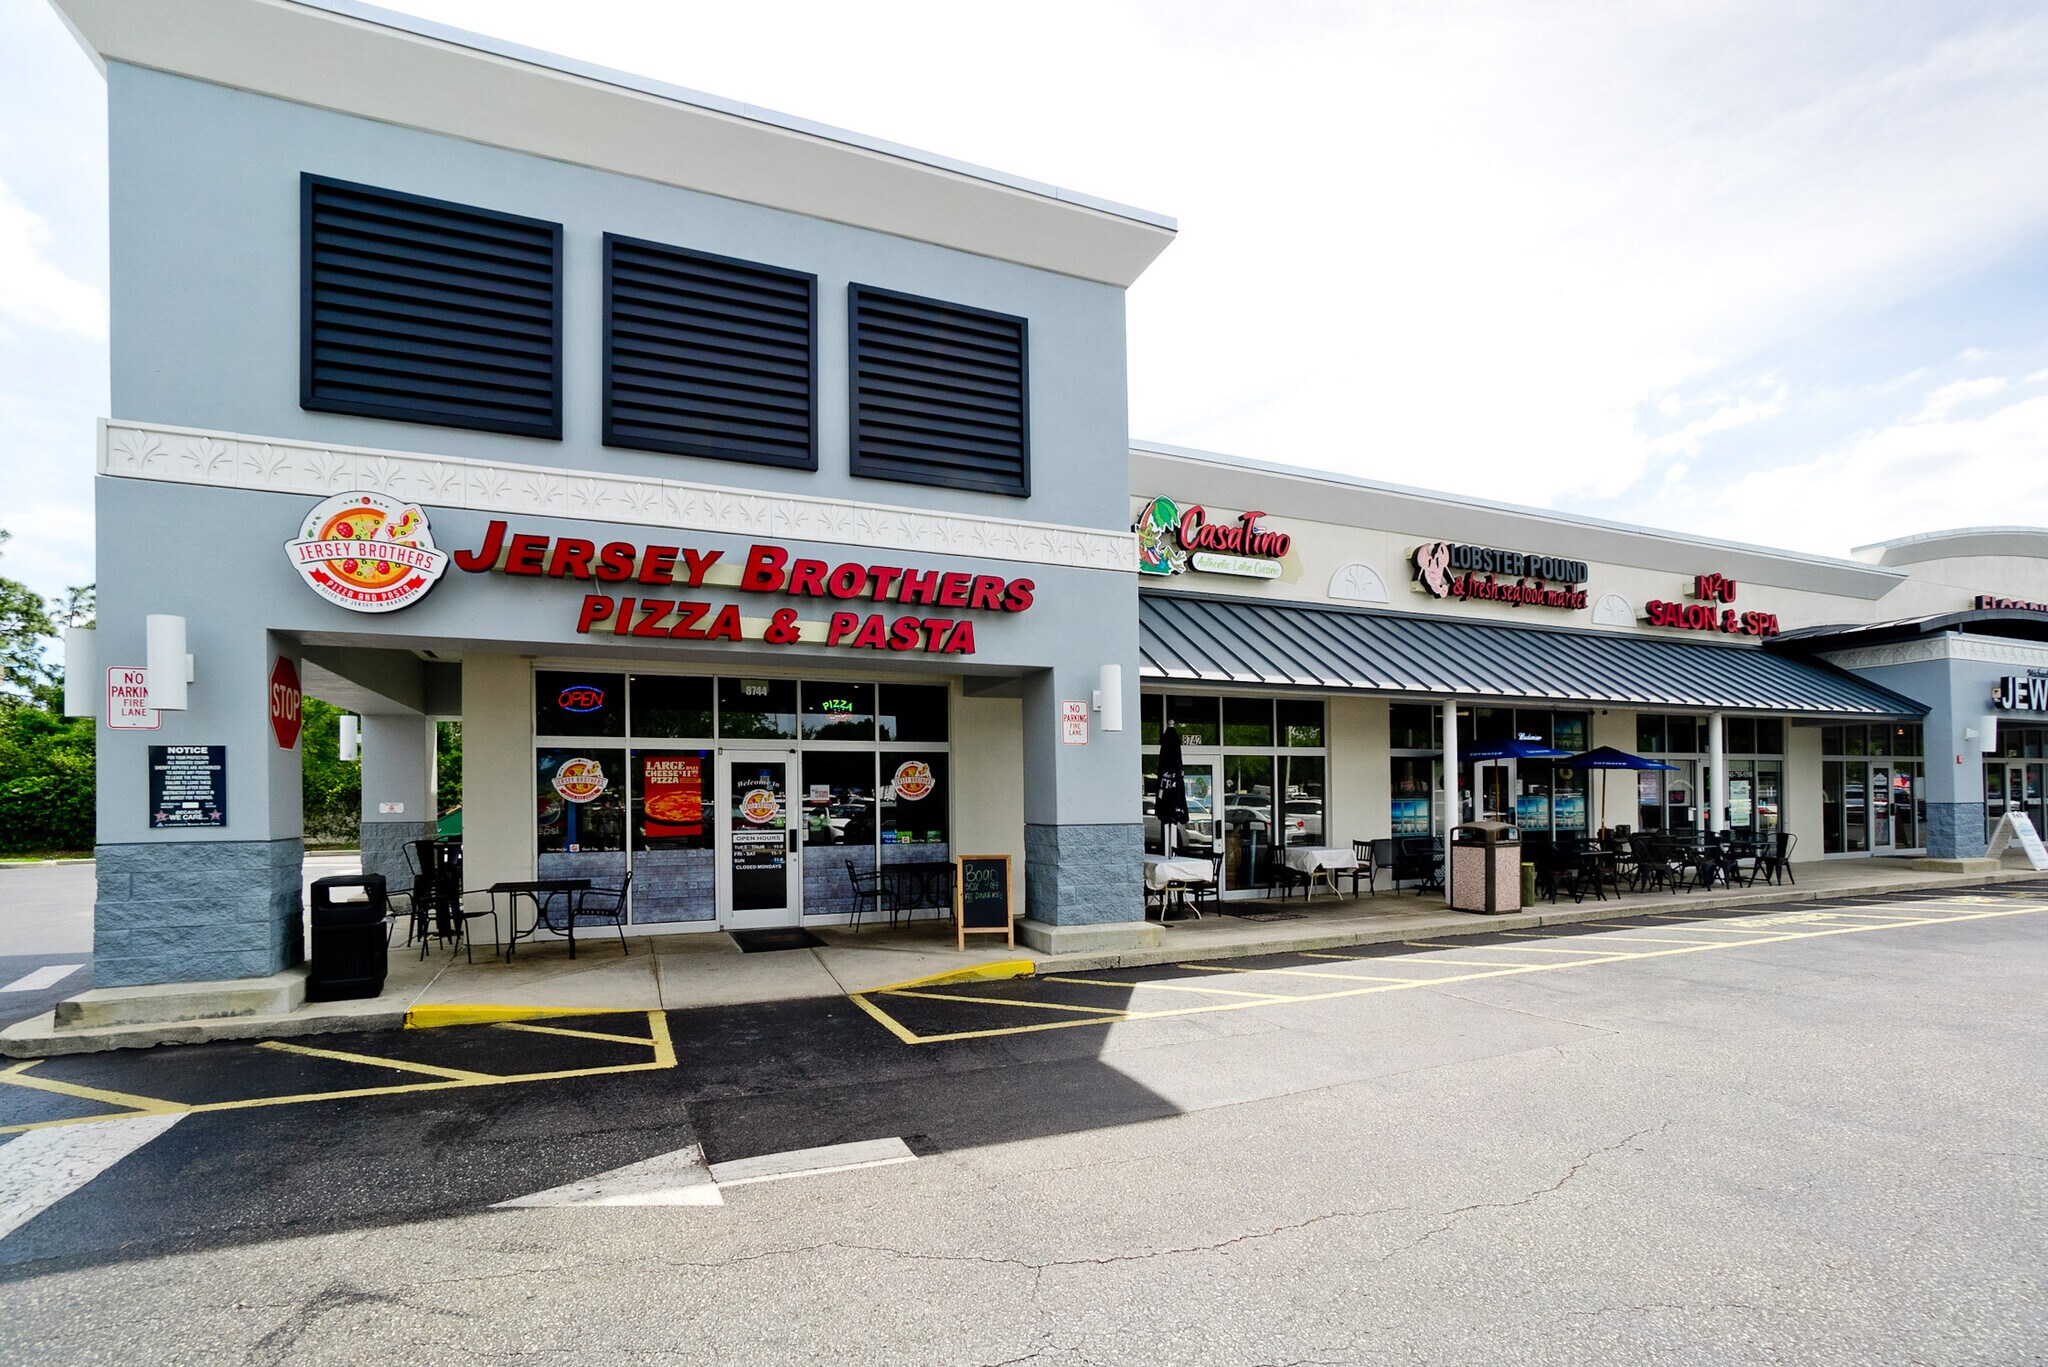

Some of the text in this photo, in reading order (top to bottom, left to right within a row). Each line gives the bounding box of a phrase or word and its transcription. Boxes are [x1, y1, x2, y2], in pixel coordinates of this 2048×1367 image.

[299, 542, 434, 570] JERSEY BROTHERS
[454, 520, 1036, 613] JERSEY BROTHERS
[1197, 555, 1279, 575] Authentic Latin Cuisine
[1450, 544, 1589, 584] LOBSTER POUND
[321, 587, 339, 600] SLICE
[325, 579, 411, 602] PIZZA AND PASTA
[1453, 570, 1588, 610] & fresh seafood market
[576, 594, 977, 655] PIZZA & PASTA
[1646, 600, 1780, 637] SALON & SPA
[124, 672, 145, 685] NO
[111, 686, 149, 698] PARKIN
[745, 685, 768, 697] 8744
[123, 699, 145, 708] FIRE
[272, 682, 301, 722] STOP
[558, 691, 604, 708] OPEN
[822, 699, 853, 712] PIZZA
[121, 708, 147, 717] LANE
[1069, 704, 1081, 714] NO
[1063, 713, 1087, 723] PARKING
[1182, 734, 1202, 746] 8742
[646, 761, 685, 770] LARGE
[737, 779, 771, 788] Welcome
[965, 864, 998, 886] Bogo
